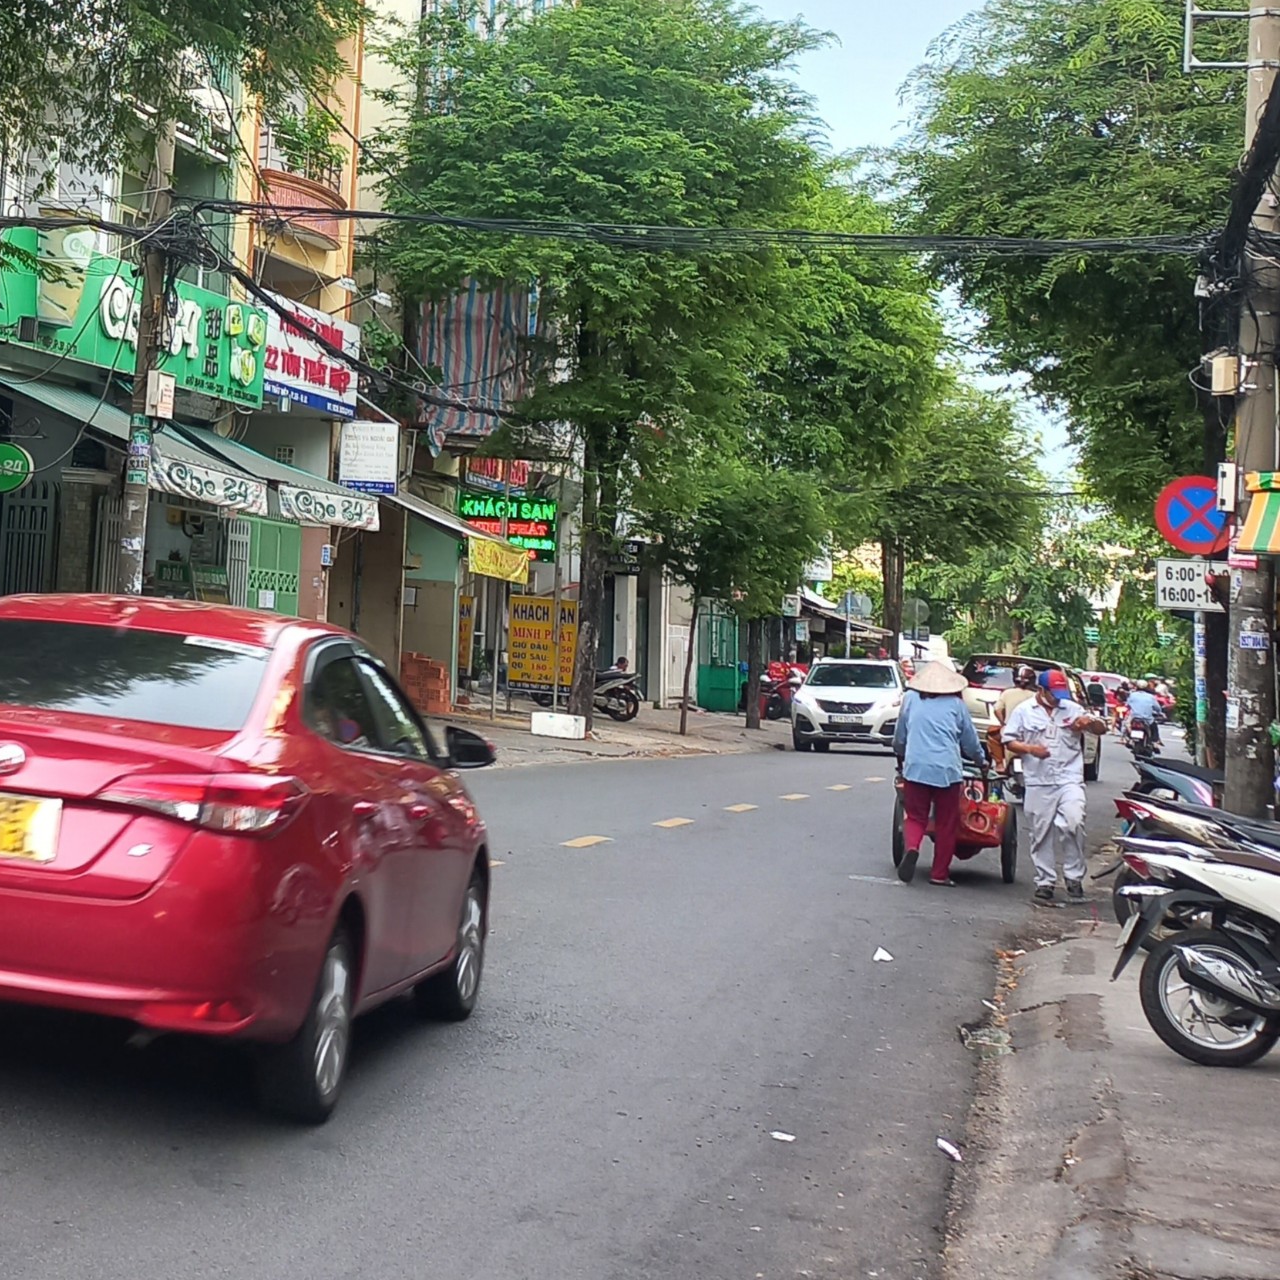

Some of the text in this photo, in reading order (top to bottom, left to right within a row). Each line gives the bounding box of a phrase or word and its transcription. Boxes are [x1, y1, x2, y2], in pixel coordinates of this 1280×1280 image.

[168, 462, 250, 503] Chè 24
[295, 491, 365, 521] Chè 24
[463, 497, 554, 522] KHÁCH SẠN
[513, 601, 550, 622] KHÁCH
[513, 627, 541, 640] MINH
